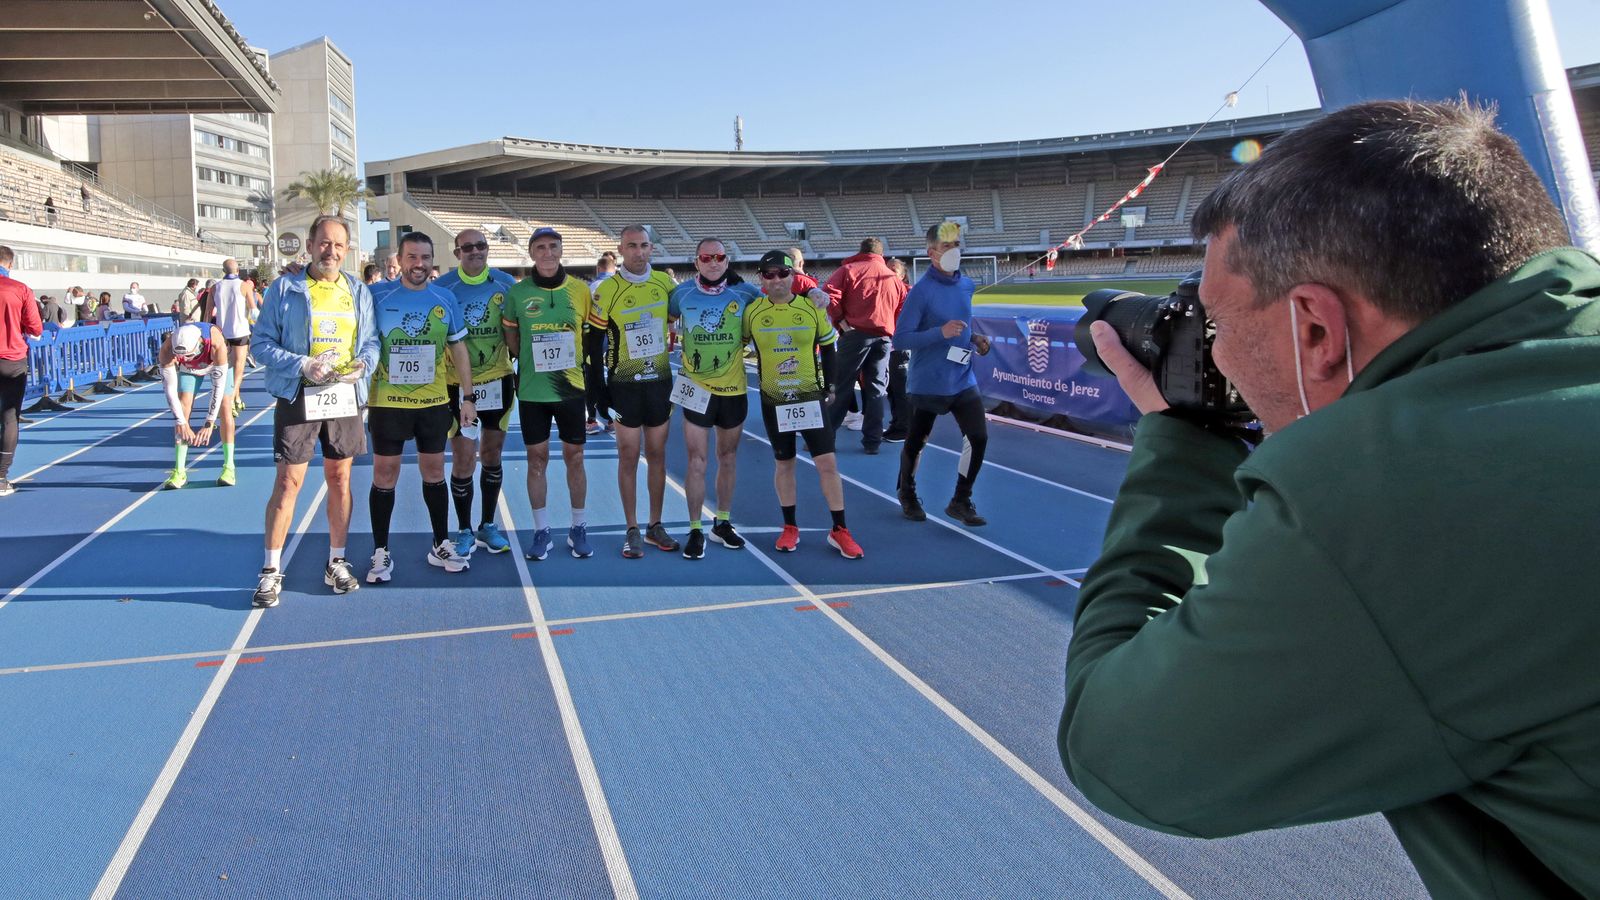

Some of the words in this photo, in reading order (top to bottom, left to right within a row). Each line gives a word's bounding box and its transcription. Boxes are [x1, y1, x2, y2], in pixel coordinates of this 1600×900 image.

[279, 238, 300, 248] B&B
[635, 334, 654, 346] 363
[693, 333, 734, 341] VENTURA
[542, 347, 561, 360] 137
[961, 349, 971, 363] 7
[398, 361, 420, 373] 705
[992, 367, 1052, 390] Ayuntamiento
[1054, 379, 1068, 393] de
[1070, 381, 1100, 398] Jerez
[680, 383, 695, 398] 336
[1022, 389, 1056, 405] Deportes
[315, 393, 338, 406] 728
[785, 407, 806, 419] 765
